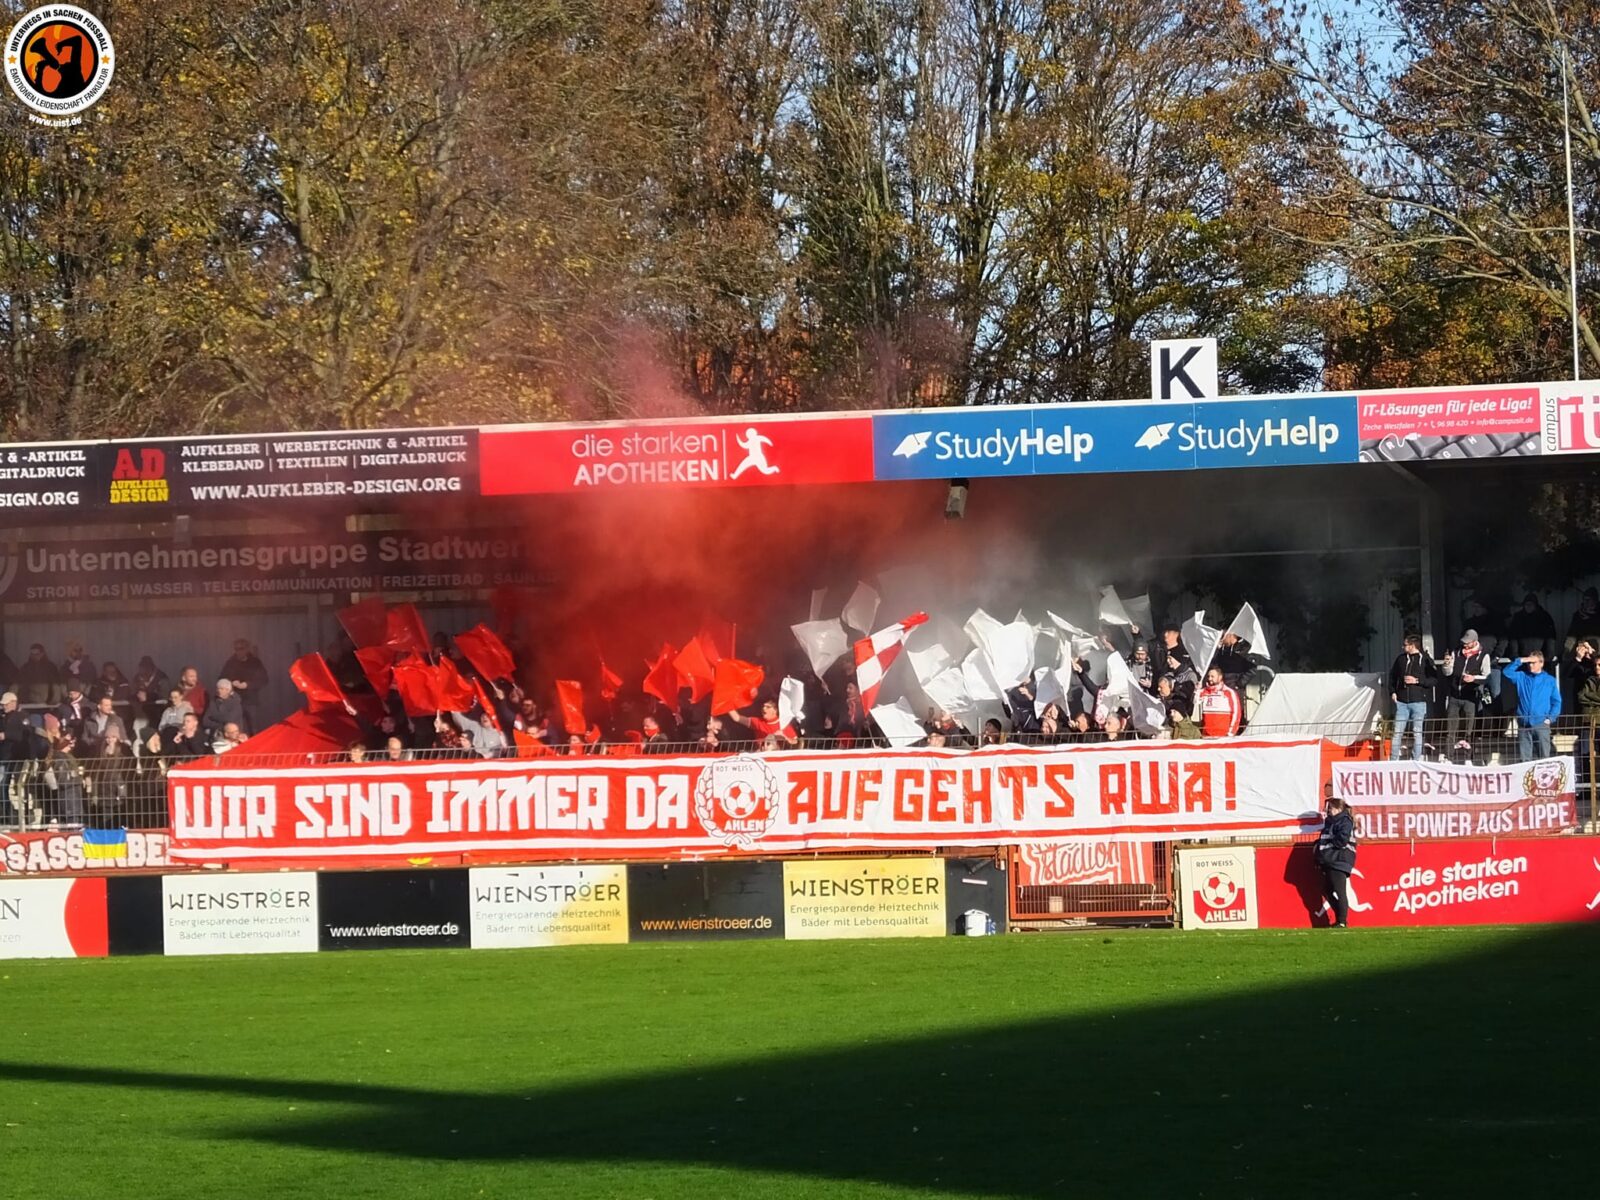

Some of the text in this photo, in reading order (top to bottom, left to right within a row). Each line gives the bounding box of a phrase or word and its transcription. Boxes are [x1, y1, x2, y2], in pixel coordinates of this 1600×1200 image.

[1160, 346, 1206, 400] K
[1362, 396, 1533, 418] IT-Lösungen für jede Liga!
[1177, 416, 1340, 456] StudyHelp
[1545, 397, 1559, 452] campus
[181, 435, 468, 457] AUFKLEBER WERBETECHNIK & -ARTIKEL
[572, 430, 718, 458] die starken
[935, 424, 1094, 463] StudyHelp
[8, 452, 18, 463] &
[22, 450, 86, 462] -ARTIKEL
[182, 451, 467, 473] KLEBEBAND TEXTILIEN DIGITALDRUCK
[110, 479, 167, 489] AUFKLEBER
[574, 459, 719, 486] APOTHEKEN
[110, 487, 169, 504] DESIGN
[191, 477, 461, 500] WWW.AUFKLEBER-DESIGN.ORG
[26, 543, 368, 573] Unternehmensgruppe
[27, 586, 79, 599] STROM
[90, 584, 120, 597] GAS
[130, 582, 193, 596] WASSER
[203, 576, 372, 593] TELEKOMMUNIKATION
[383, 574, 483, 588] FREIZEITBAD
[1340, 770, 1512, 796] KEIN WEG ZU WEIT
[174, 785, 277, 839] WIR
[295, 782, 411, 839] SIND
[426, 775, 608, 833] IMMER
[626, 774, 688, 830] DA
[724, 819, 765, 831] AHLEN
[1354, 801, 1570, 839] OLLE POWER AUS LIPPE
[1442, 856, 1527, 884] starken
[476, 881, 620, 903] WIENSTRÖER
[790, 874, 939, 897] WIENSTRÖER
[1393, 879, 1519, 914] Apotheken
[169, 888, 310, 910] WIENSTRÖER
[790, 902, 939, 915] Energiesparende Heiztechnik
[641, 915, 772, 931] www.wienstroeer.de
[801, 915, 929, 927] Bäder mit Lebensqualität
[1205, 909, 1246, 922] AHLEN
[330, 922, 459, 937] www.wienstroeer.de
